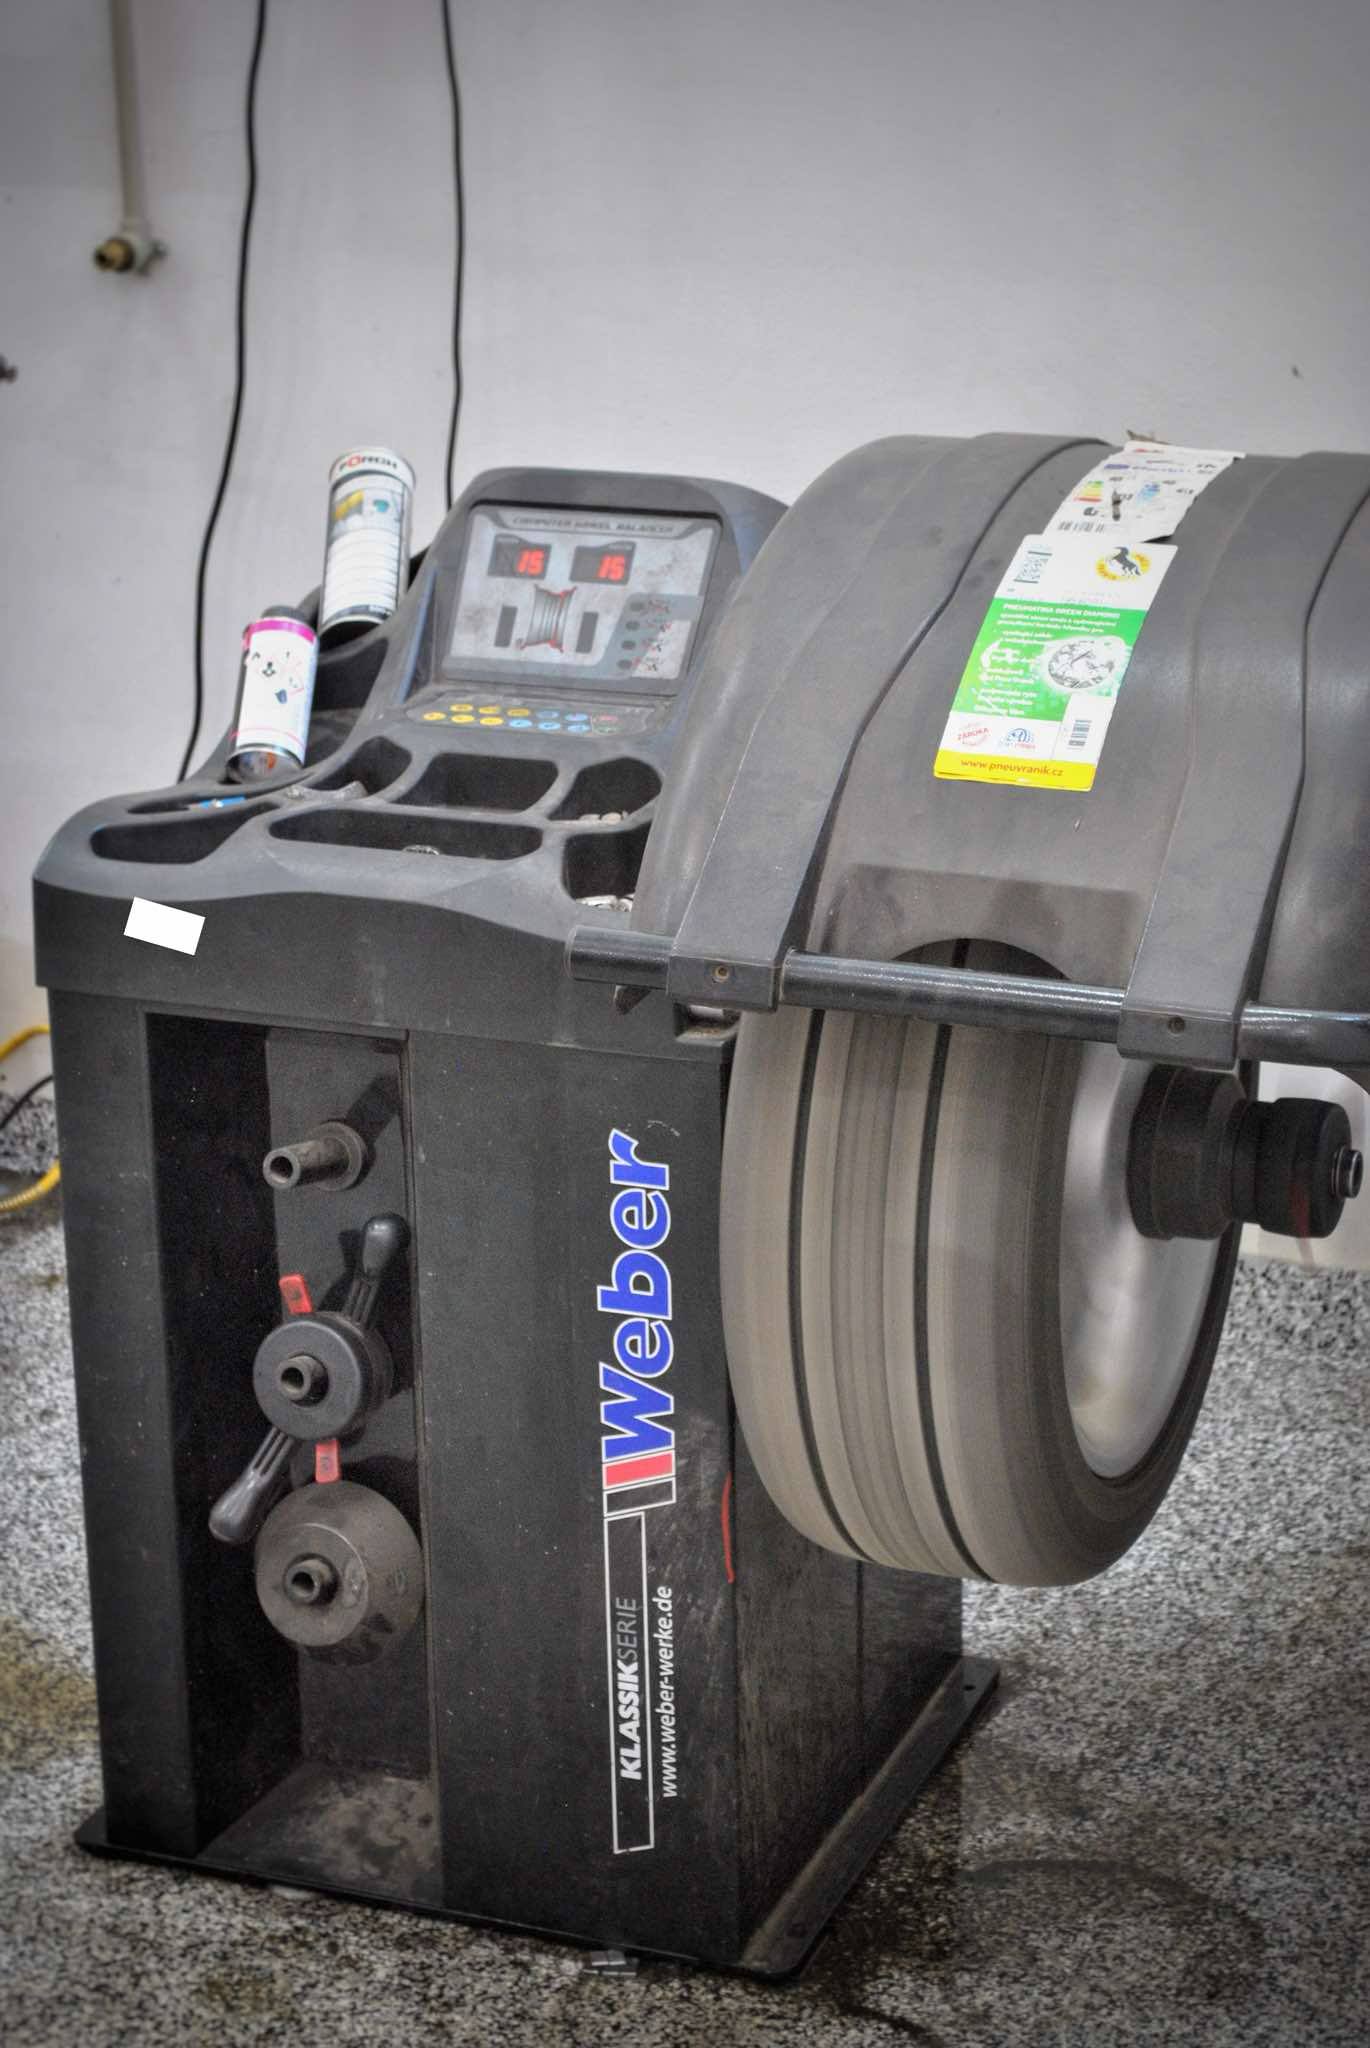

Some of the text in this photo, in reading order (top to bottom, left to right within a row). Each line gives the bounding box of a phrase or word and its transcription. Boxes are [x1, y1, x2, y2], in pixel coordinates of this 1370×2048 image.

[516, 548, 545, 576] 15
[597, 553, 626, 581] 15
[960, 759, 1064, 777] www.pneuvranik.cz
[597, 1127, 674, 1463] Weber
[652, 1585, 678, 1798] www.weber-werke.de
